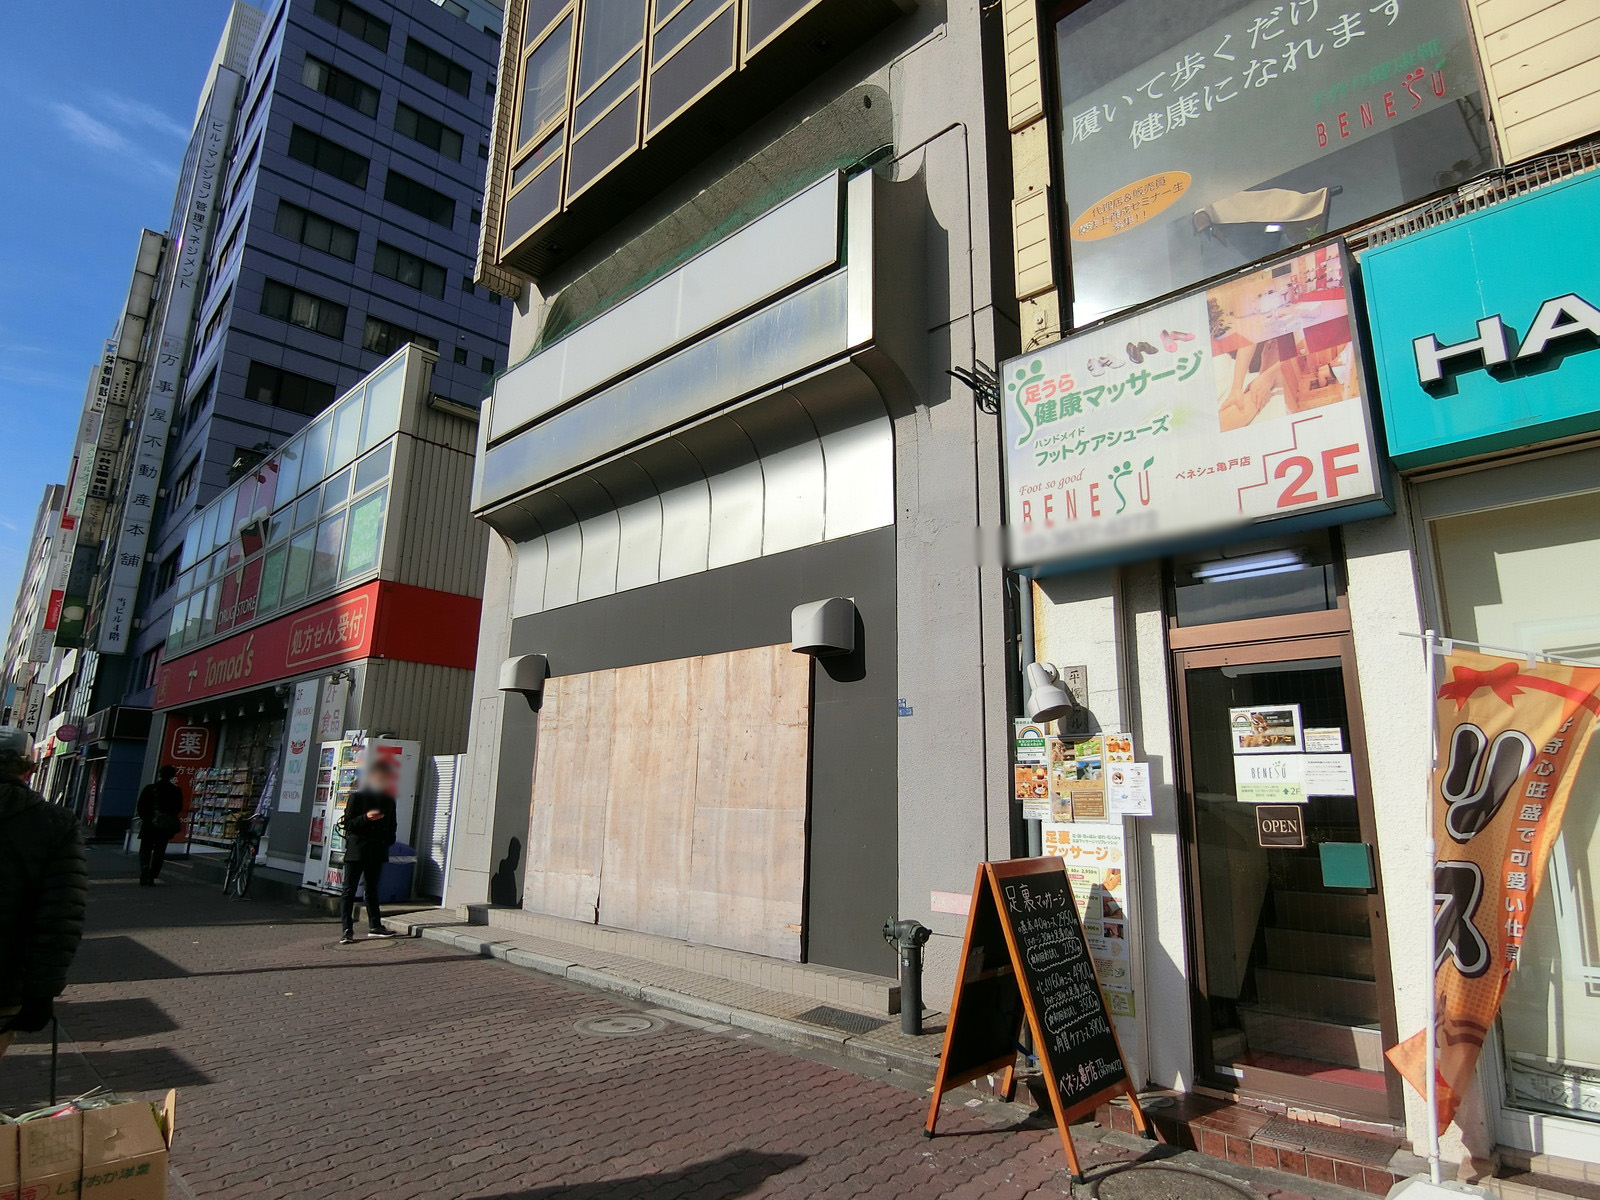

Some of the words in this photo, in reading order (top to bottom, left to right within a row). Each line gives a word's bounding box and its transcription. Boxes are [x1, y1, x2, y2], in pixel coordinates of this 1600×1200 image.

[1071, 0, 1318, 145] 履いて歩くだけ
[1129, 0, 1400, 149] 健康になれます
[1024, 373, 1075, 405] 足うら
[1034, 350, 1203, 427] 健康マッサージ
[1034, 426, 1086, 449] ハンドメイド
[1035, 414, 1170, 467] フットケアシューズ
[1019, 483, 1043, 496] Foot
[1045, 480, 1056, 489] so
[1057, 467, 1086, 490] good
[1175, 456, 1251, 480] ベネシュ亀戸店
[1274, 443, 1360, 508] 2F
[290, 606, 364, 656] 処方せん受付
[204, 633, 254, 688] Tomod's
[177, 732, 203, 754] 薬
[1045, 830, 1071, 845] 足裏
[1262, 819, 1298, 833] OPEN
[1045, 844, 1109, 861] マッサージ
